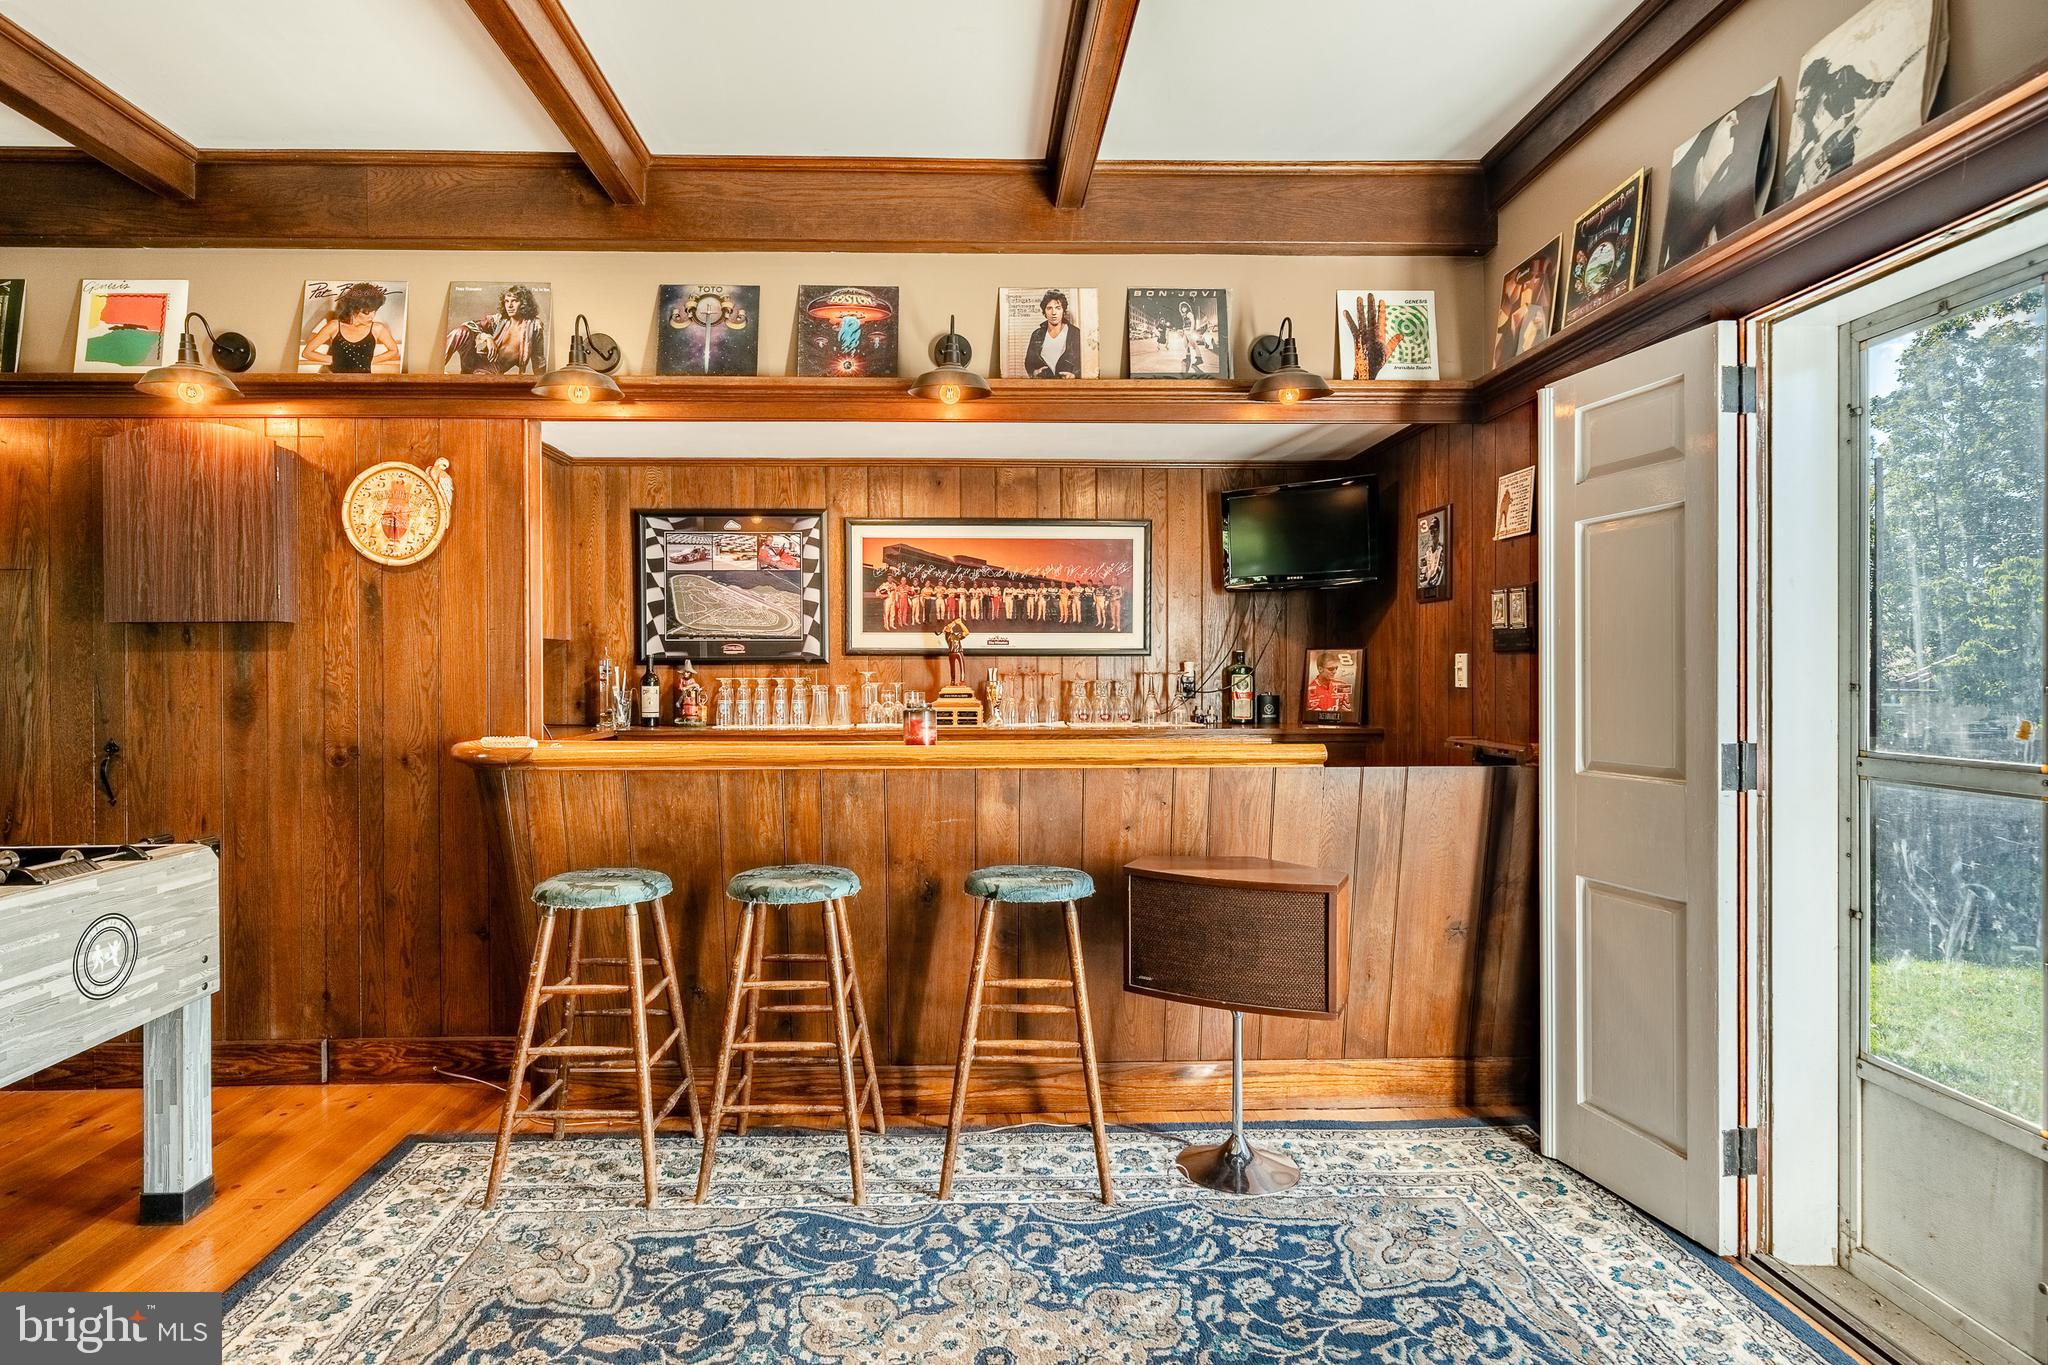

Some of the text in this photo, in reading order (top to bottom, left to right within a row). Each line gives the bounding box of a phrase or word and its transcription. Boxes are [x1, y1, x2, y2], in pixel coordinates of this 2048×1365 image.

[308, 282, 338, 299] Pat
[698, 285, 723, 293] TOTO
[1178, 290, 1217, 298] JOVI
[830, 294, 873, 305] BOSTON
[1420, 519, 1429, 533] 3
[1338, 653, 1354, 666] 8
